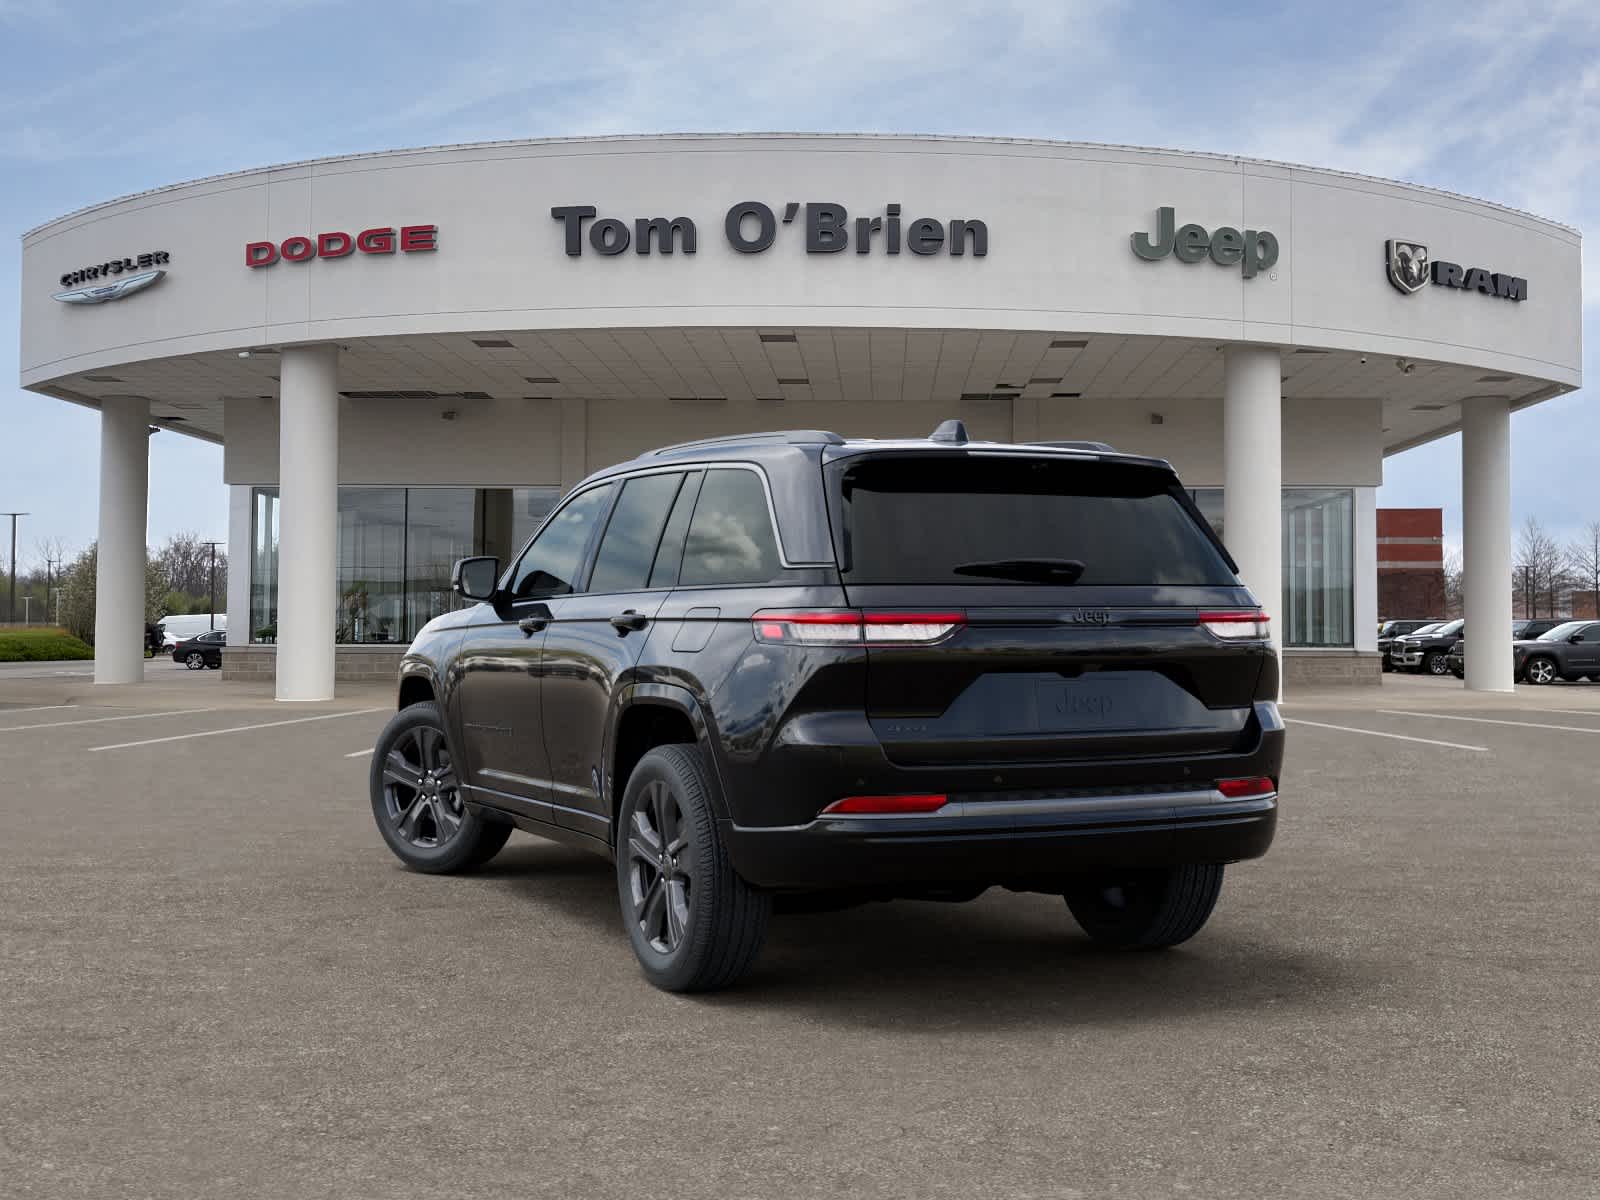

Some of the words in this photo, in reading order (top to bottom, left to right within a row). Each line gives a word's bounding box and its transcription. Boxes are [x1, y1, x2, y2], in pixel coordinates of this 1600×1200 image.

[246, 225, 438, 268] DODGE
[551, 205, 697, 257] Tom
[725, 201, 989, 257] O'Brien
[1131, 206, 1279, 279] Jeep
[60, 250, 170, 287] CHRYSLER
[1431, 261, 1528, 302] RAM
[1072, 608, 1112, 626] Jeep
[1056, 687, 1113, 721] Jeep
